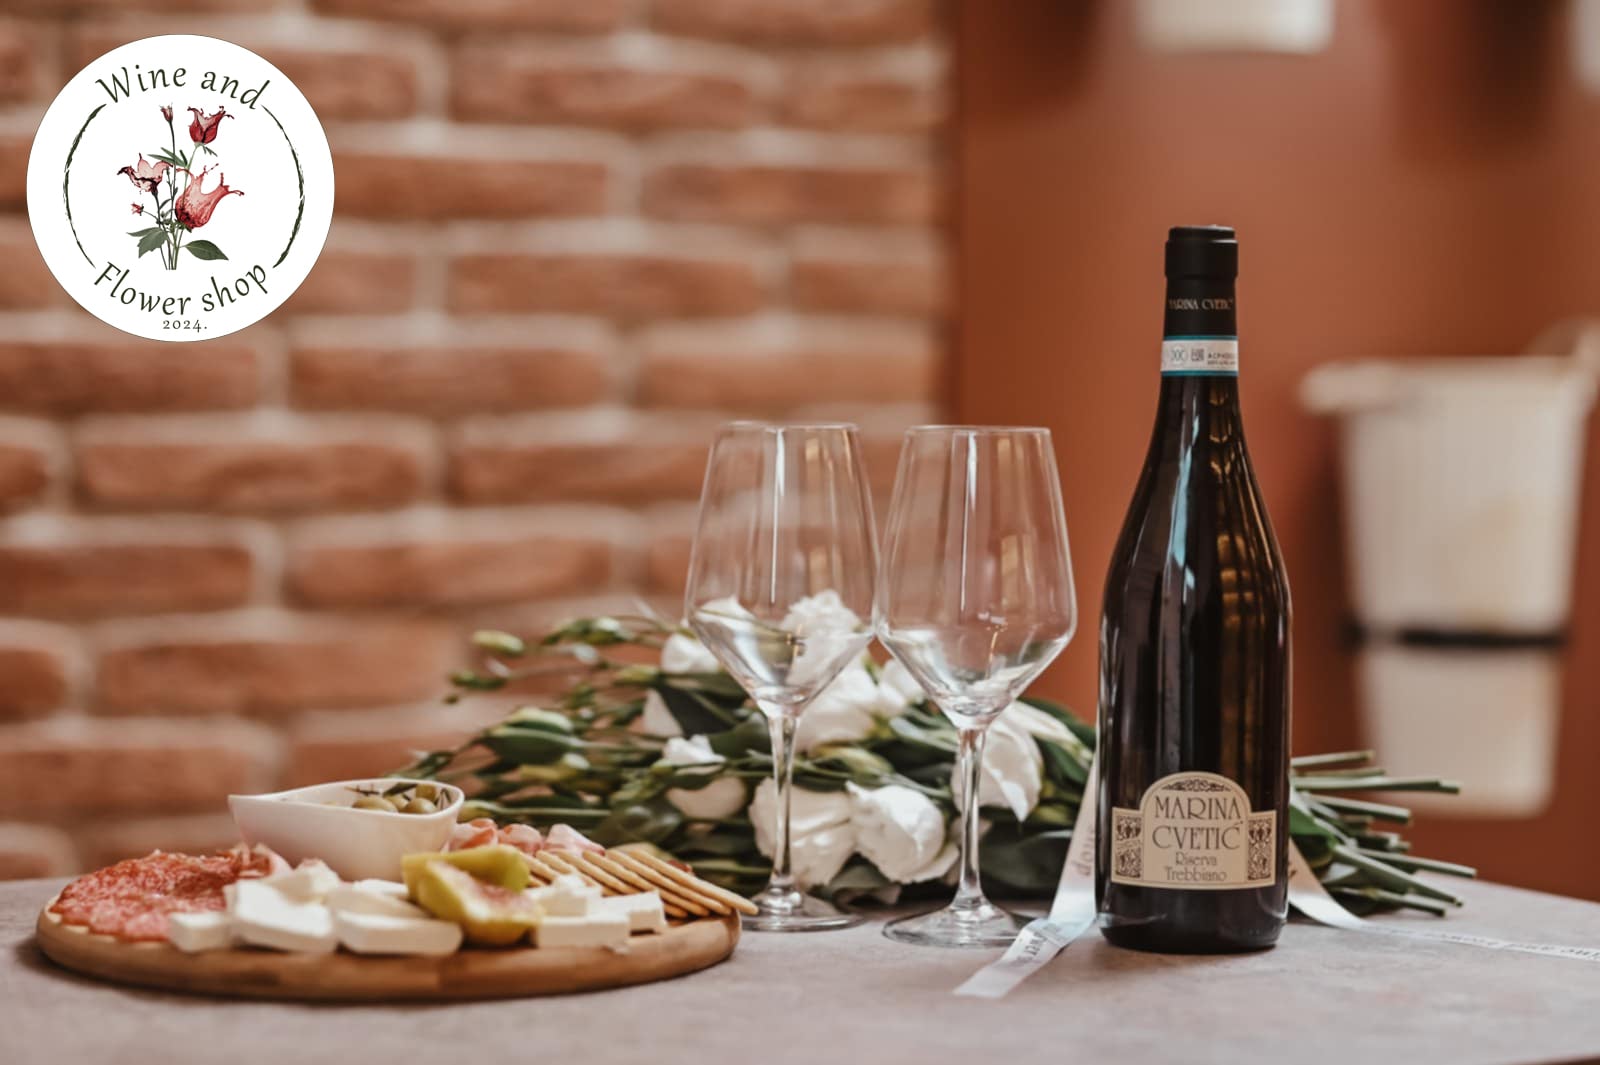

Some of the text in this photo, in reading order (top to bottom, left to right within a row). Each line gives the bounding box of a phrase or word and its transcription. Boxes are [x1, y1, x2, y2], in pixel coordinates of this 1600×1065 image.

[1154, 795, 1242, 821] MARINA
[1175, 851, 1218, 867] Riserva
[1164, 866, 1228, 882] Trebbiano
